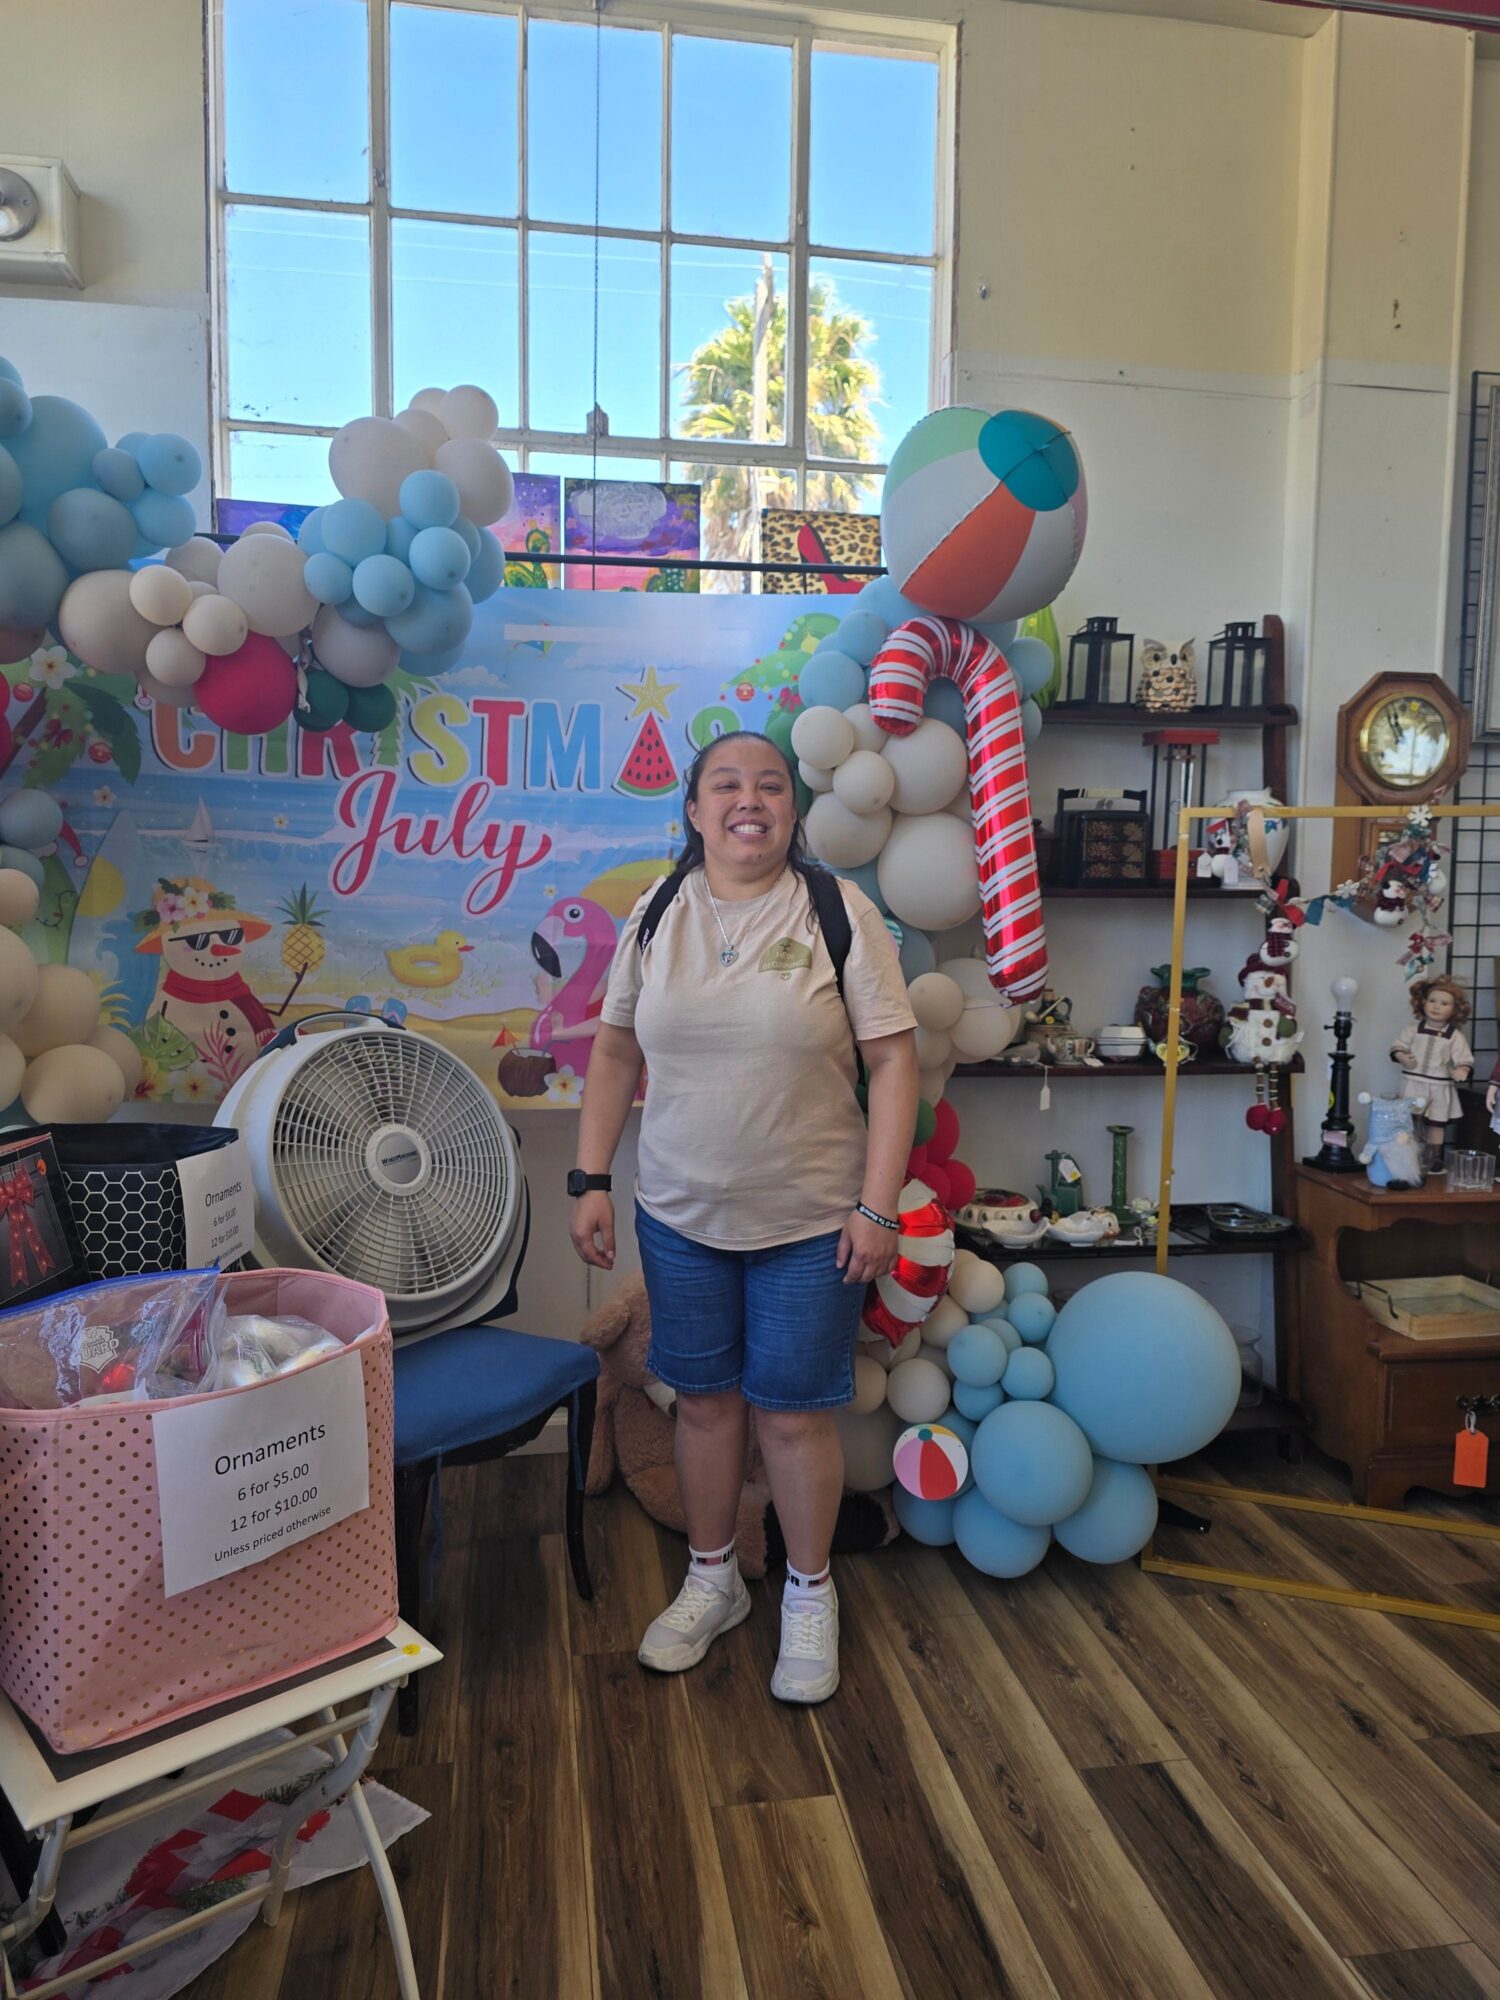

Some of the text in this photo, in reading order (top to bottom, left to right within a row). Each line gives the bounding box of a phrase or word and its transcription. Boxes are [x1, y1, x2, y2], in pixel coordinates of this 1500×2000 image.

[332, 769, 552, 915] July
[205, 1181, 242, 1207] Ornaments
[211, 1237, 218, 1248] 12
[218, 1234, 226, 1245] for
[80, 1338, 120, 1361] UARD
[214, 1423, 326, 1475] Ornaments
[237, 1463, 310, 1501] 6 for $5.00
[231, 1486, 318, 1532] 12 for $10.00
[214, 1506, 331, 1562] Unless priced otherwise
